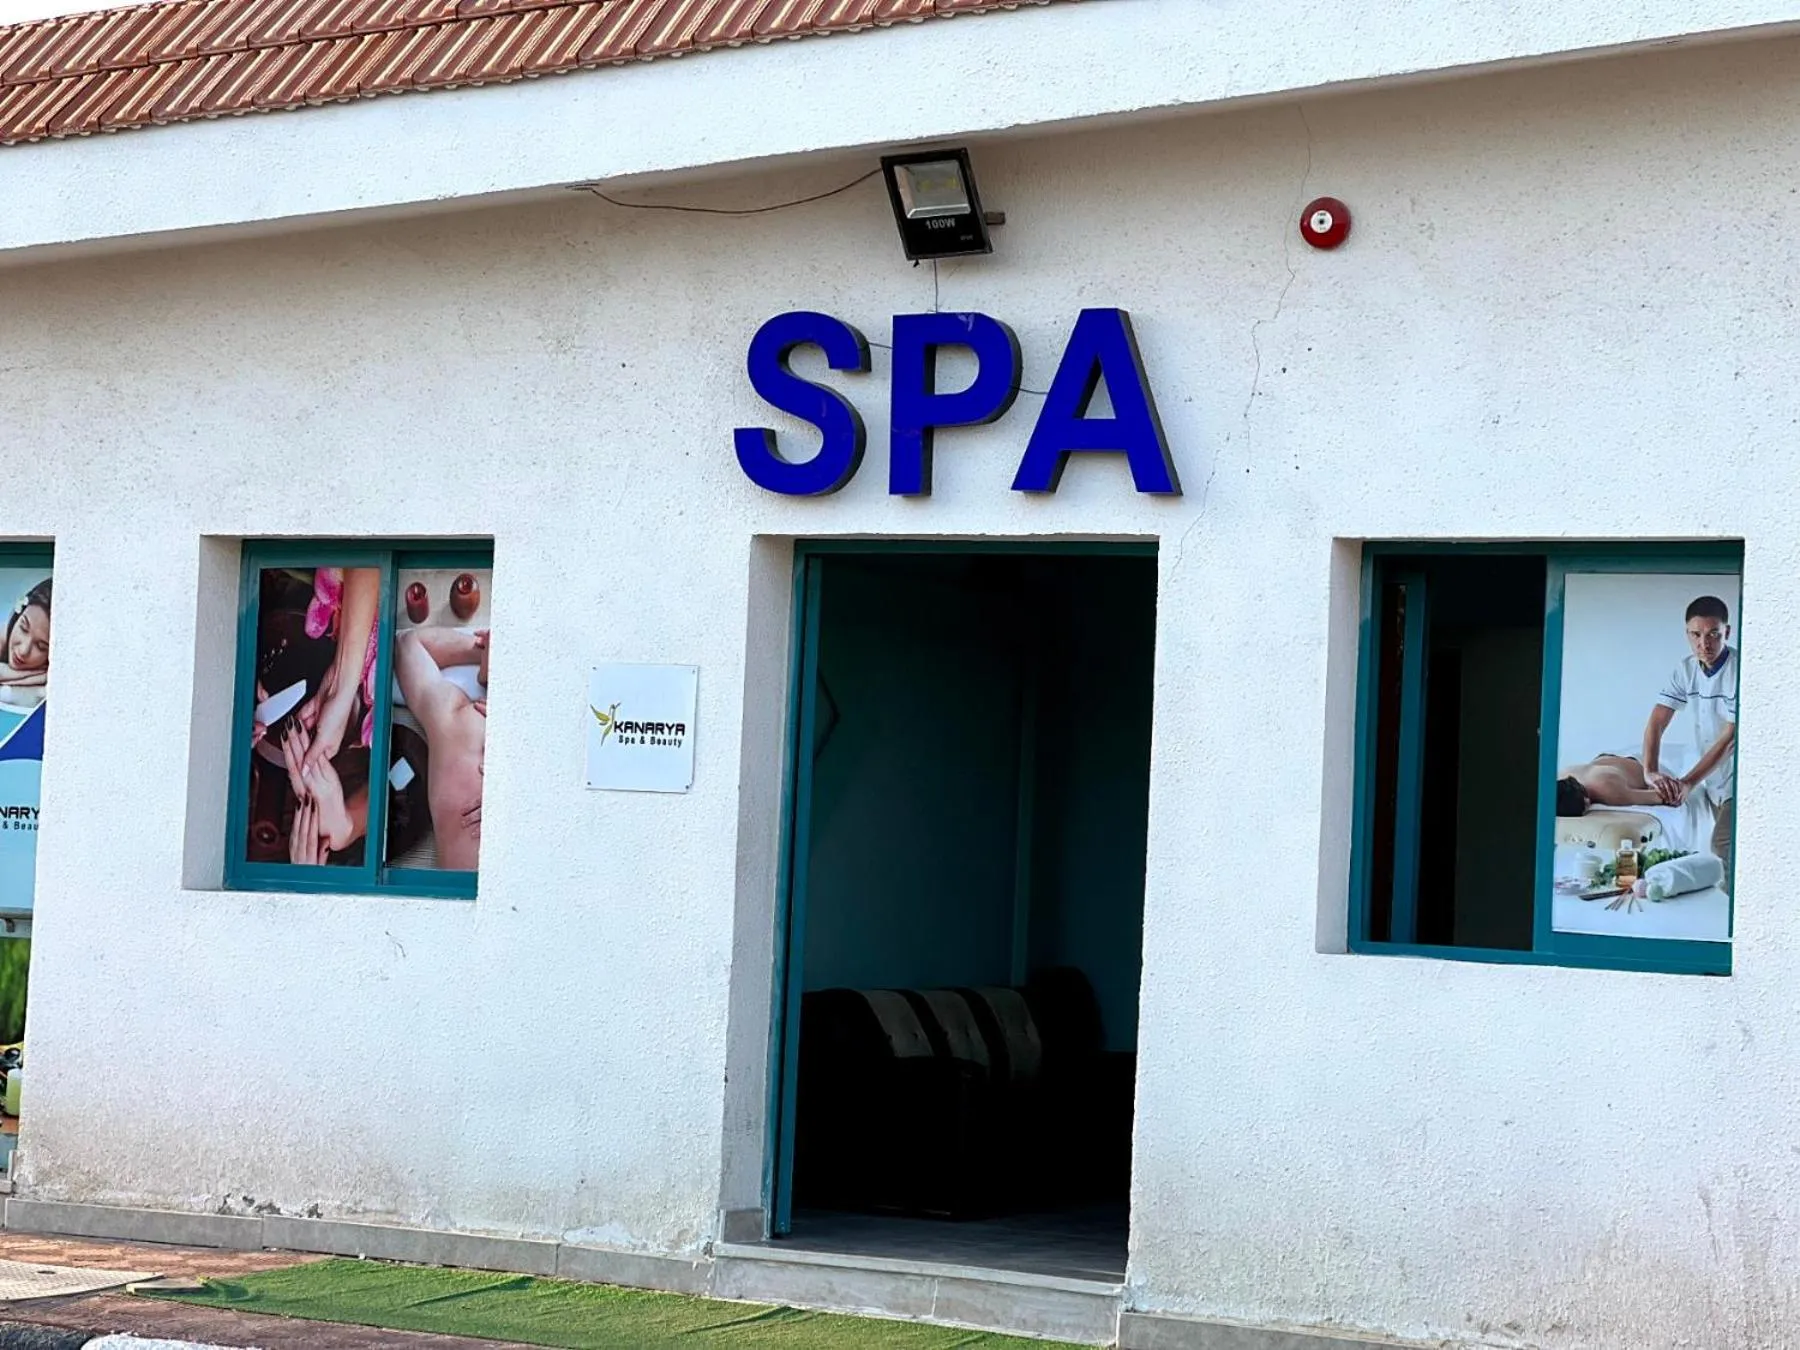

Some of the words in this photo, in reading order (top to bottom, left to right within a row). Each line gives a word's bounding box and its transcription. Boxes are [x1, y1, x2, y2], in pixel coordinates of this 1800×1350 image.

[925, 217, 956, 230] 100W
[733, 307, 1183, 497] SPA
[613, 720, 686, 737] KANARYA
[618, 735, 636, 746] Spa
[639, 736, 646, 745] &
[650, 736, 683, 748] Beauty
[2, 820, 8, 830] &
